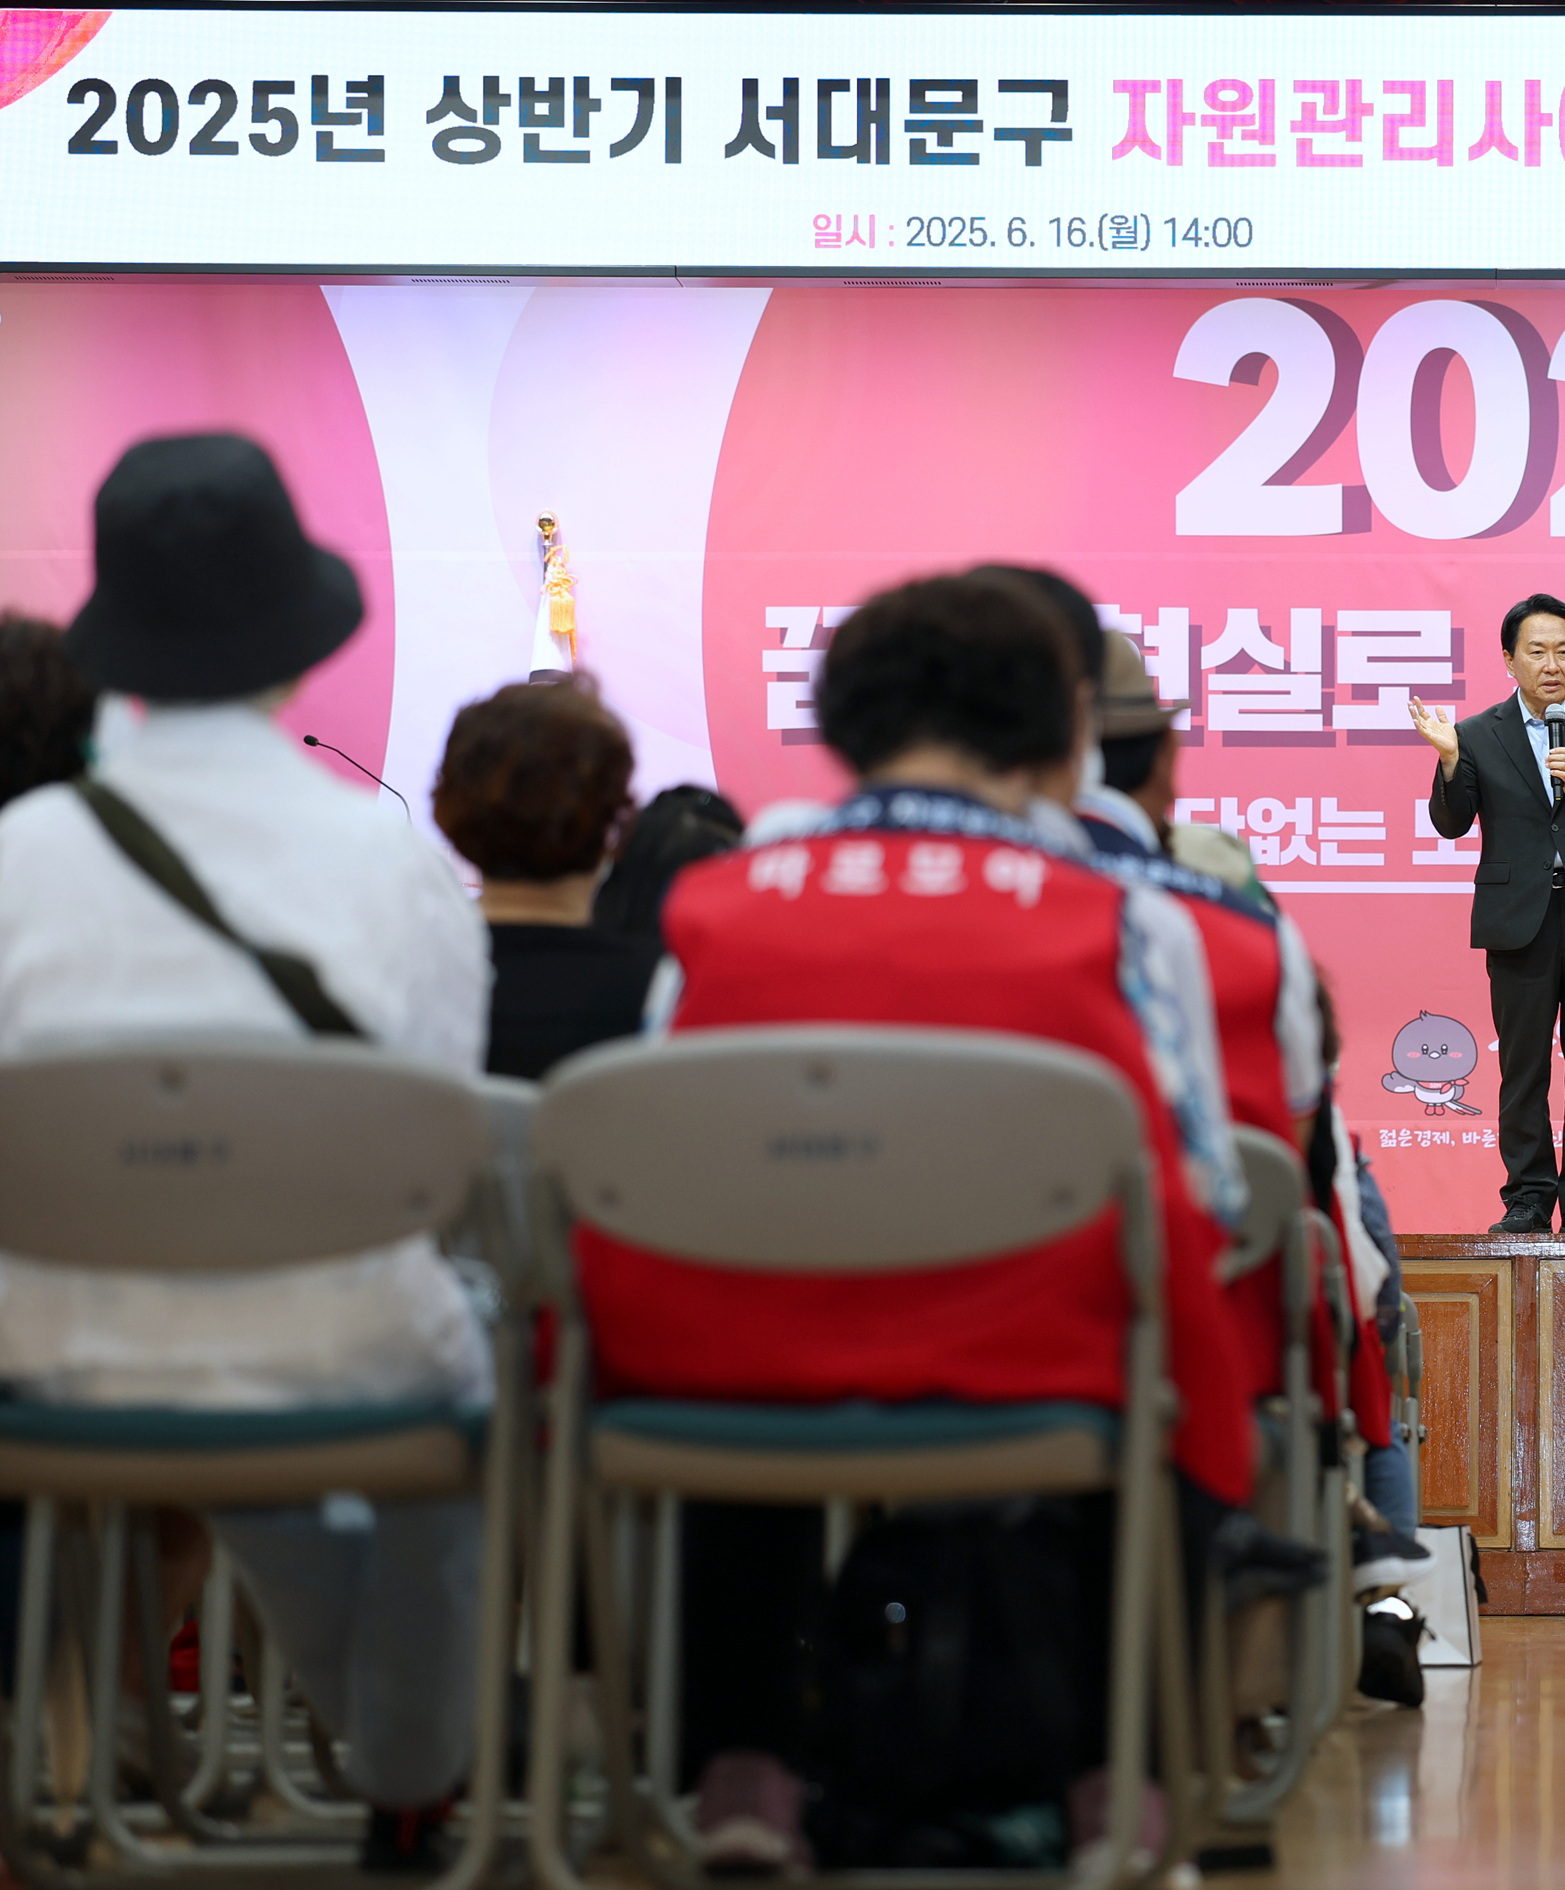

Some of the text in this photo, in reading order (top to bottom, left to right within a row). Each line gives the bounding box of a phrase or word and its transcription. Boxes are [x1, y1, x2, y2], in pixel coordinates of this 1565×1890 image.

[67, 74, 386, 164] 2025년
[425, 75, 683, 164] 상반기
[724, 77, 1074, 166] 서대문구
[813, 213, 876, 249] 일시
[906, 216, 996, 247] 2025.
[1007, 217, 1035, 247] 6.
[1049, 213, 1151, 250] 16.(월)
[1165, 217, 1253, 247] 14:00
